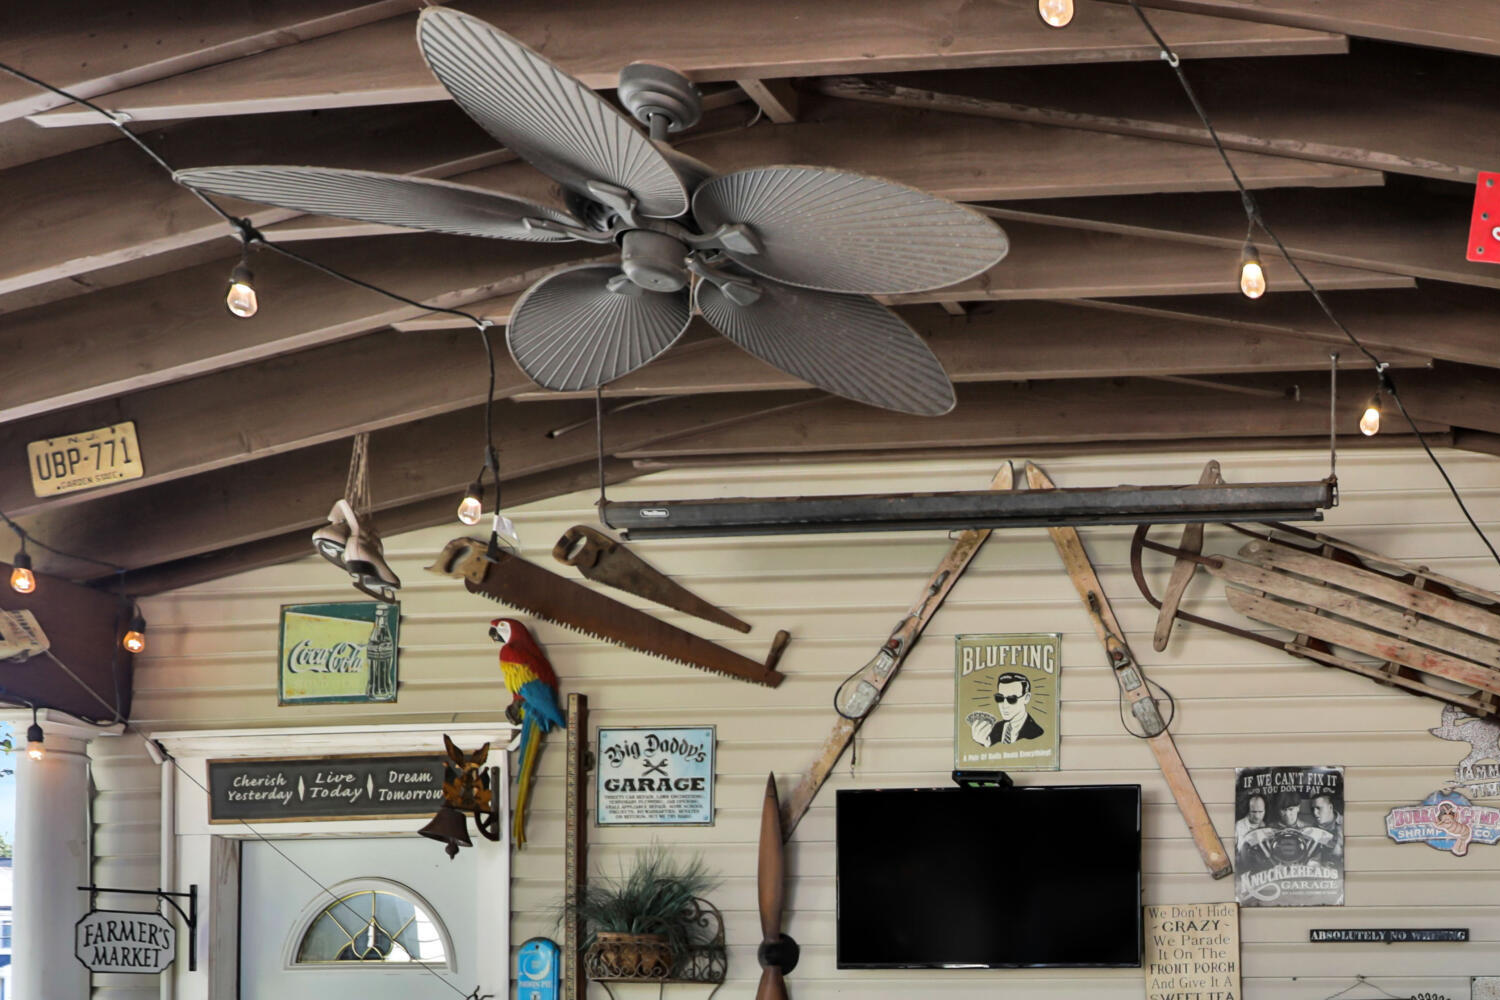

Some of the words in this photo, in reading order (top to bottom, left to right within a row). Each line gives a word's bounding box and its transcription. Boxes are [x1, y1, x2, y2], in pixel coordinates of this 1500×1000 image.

[36, 437, 132, 480] UBP-771
[962, 644, 1054, 676] BLUFFING
[604, 740, 641, 768] Big
[643, 734, 707, 762] Daddy's
[232, 773, 287, 787] Cherish
[315, 772, 356, 784] Live
[388, 771, 432, 783] Dream
[1244, 776, 1253, 788] IF
[1256, 774, 1272, 786] WE
[1275, 772, 1303, 785] CAN'T
[1307, 773, 1324, 786] FIX
[1327, 775, 1337, 787] IT
[604, 777, 705, 792] GARAGE
[1263, 786, 1279, 795] YOU
[1280, 785, 1304, 793] DON'T
[1306, 785, 1321, 794] PAY
[228, 788, 293, 805] Yesterday
[310, 785, 363, 803] Today
[378, 788, 443, 801] Tomorrow
[1241, 864, 1338, 893] KNUCKLEHEADS
[1281, 880, 1338, 890] GARAGE
[1148, 907, 1166, 918] We
[1172, 906, 1202, 918] Don't
[1207, 905, 1234, 917] Hide
[1162, 920, 1220, 933] CRAZY
[83, 920, 170, 950] FARMER'S
[1153, 935, 1175, 946] We
[1181, 934, 1231, 945] Parade
[1311, 931, 1385, 940] ABSOLUTELY
[1390, 931, 1406, 940] NO
[91, 946, 162, 967] MARKET
[1159, 949, 1168, 960] It
[1173, 948, 1192, 960] On
[1198, 947, 1227, 959] The
[1150, 963, 1189, 975] FRONT
[1194, 962, 1235, 973] PORCH
[1152, 977, 1175, 989] And
[1179, 976, 1206, 988] Give
[1211, 976, 1219, 987] It
[1223, 976, 1232, 987] A
